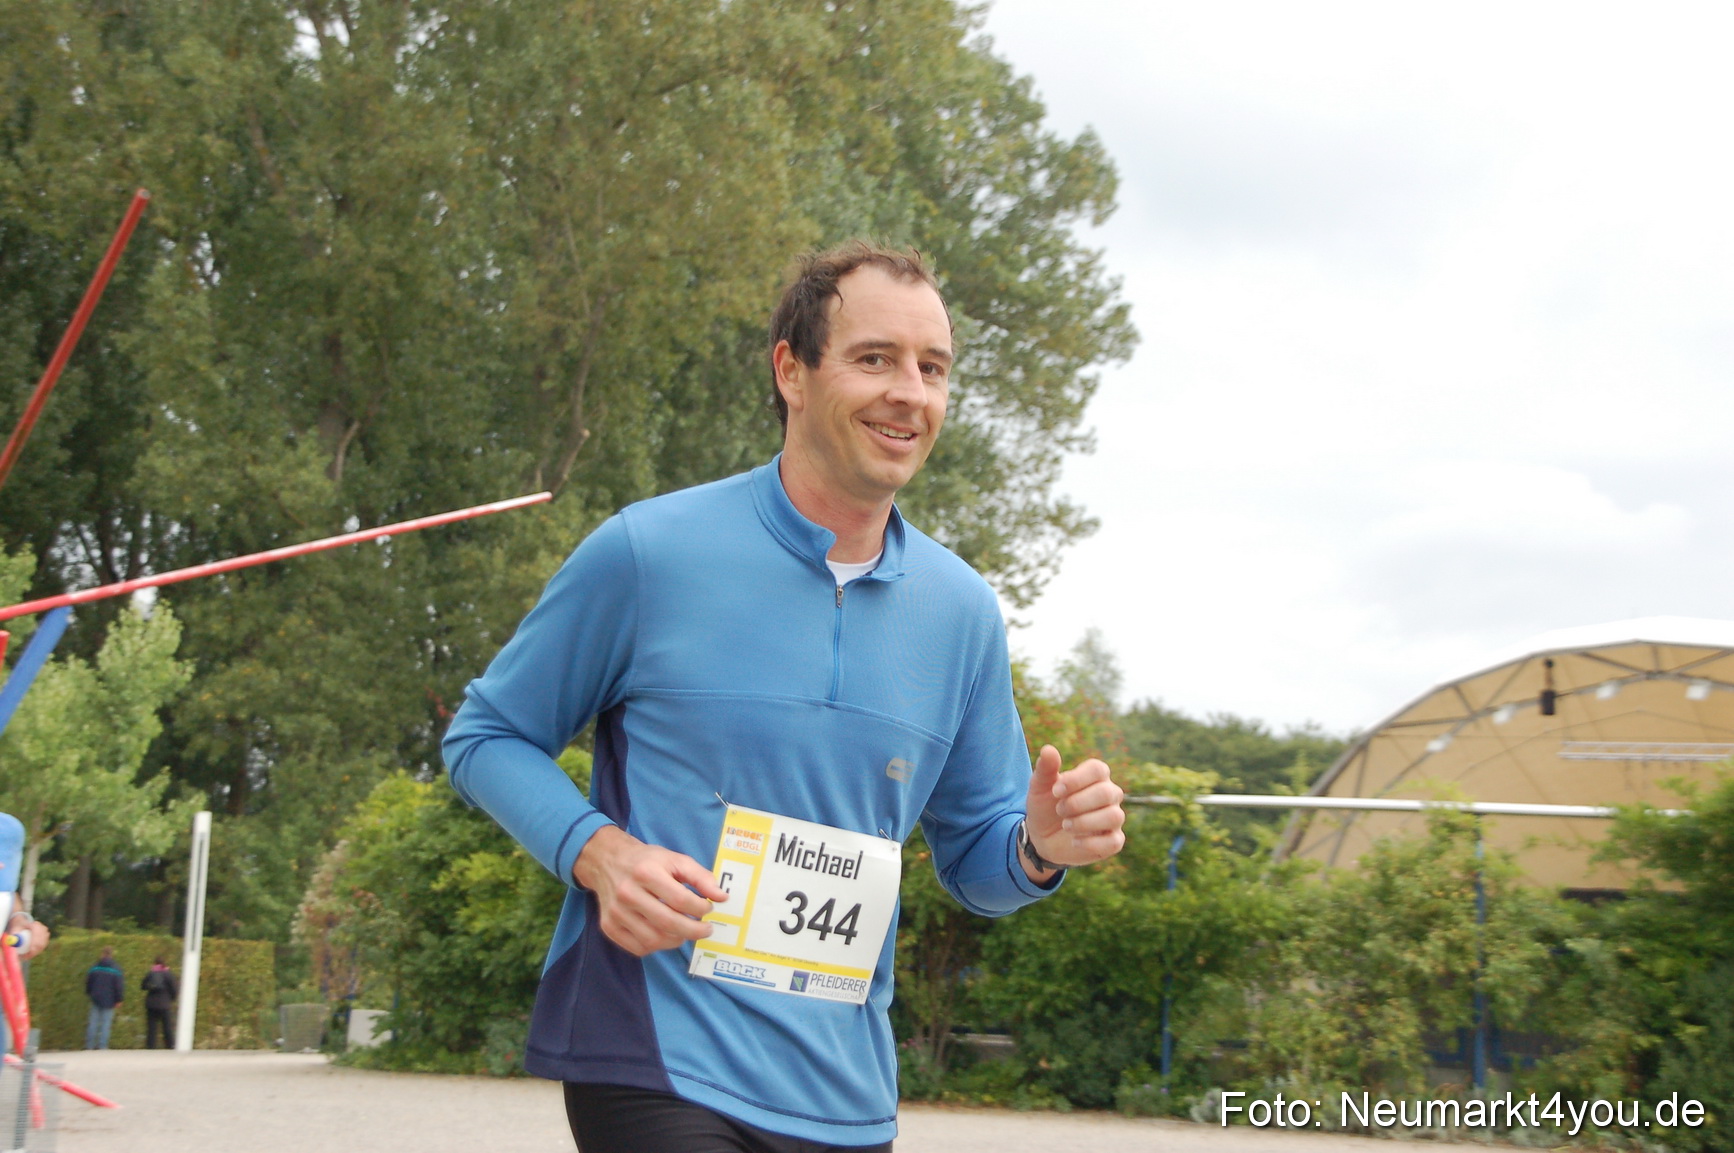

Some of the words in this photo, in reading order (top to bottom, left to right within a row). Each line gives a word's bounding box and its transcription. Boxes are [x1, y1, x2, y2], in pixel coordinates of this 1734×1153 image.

[775, 833, 863, 880] Michael
[779, 890, 862, 945] 344
[714, 959, 767, 979] BOCK
[810, 973, 867, 993] PFLEIDERER
